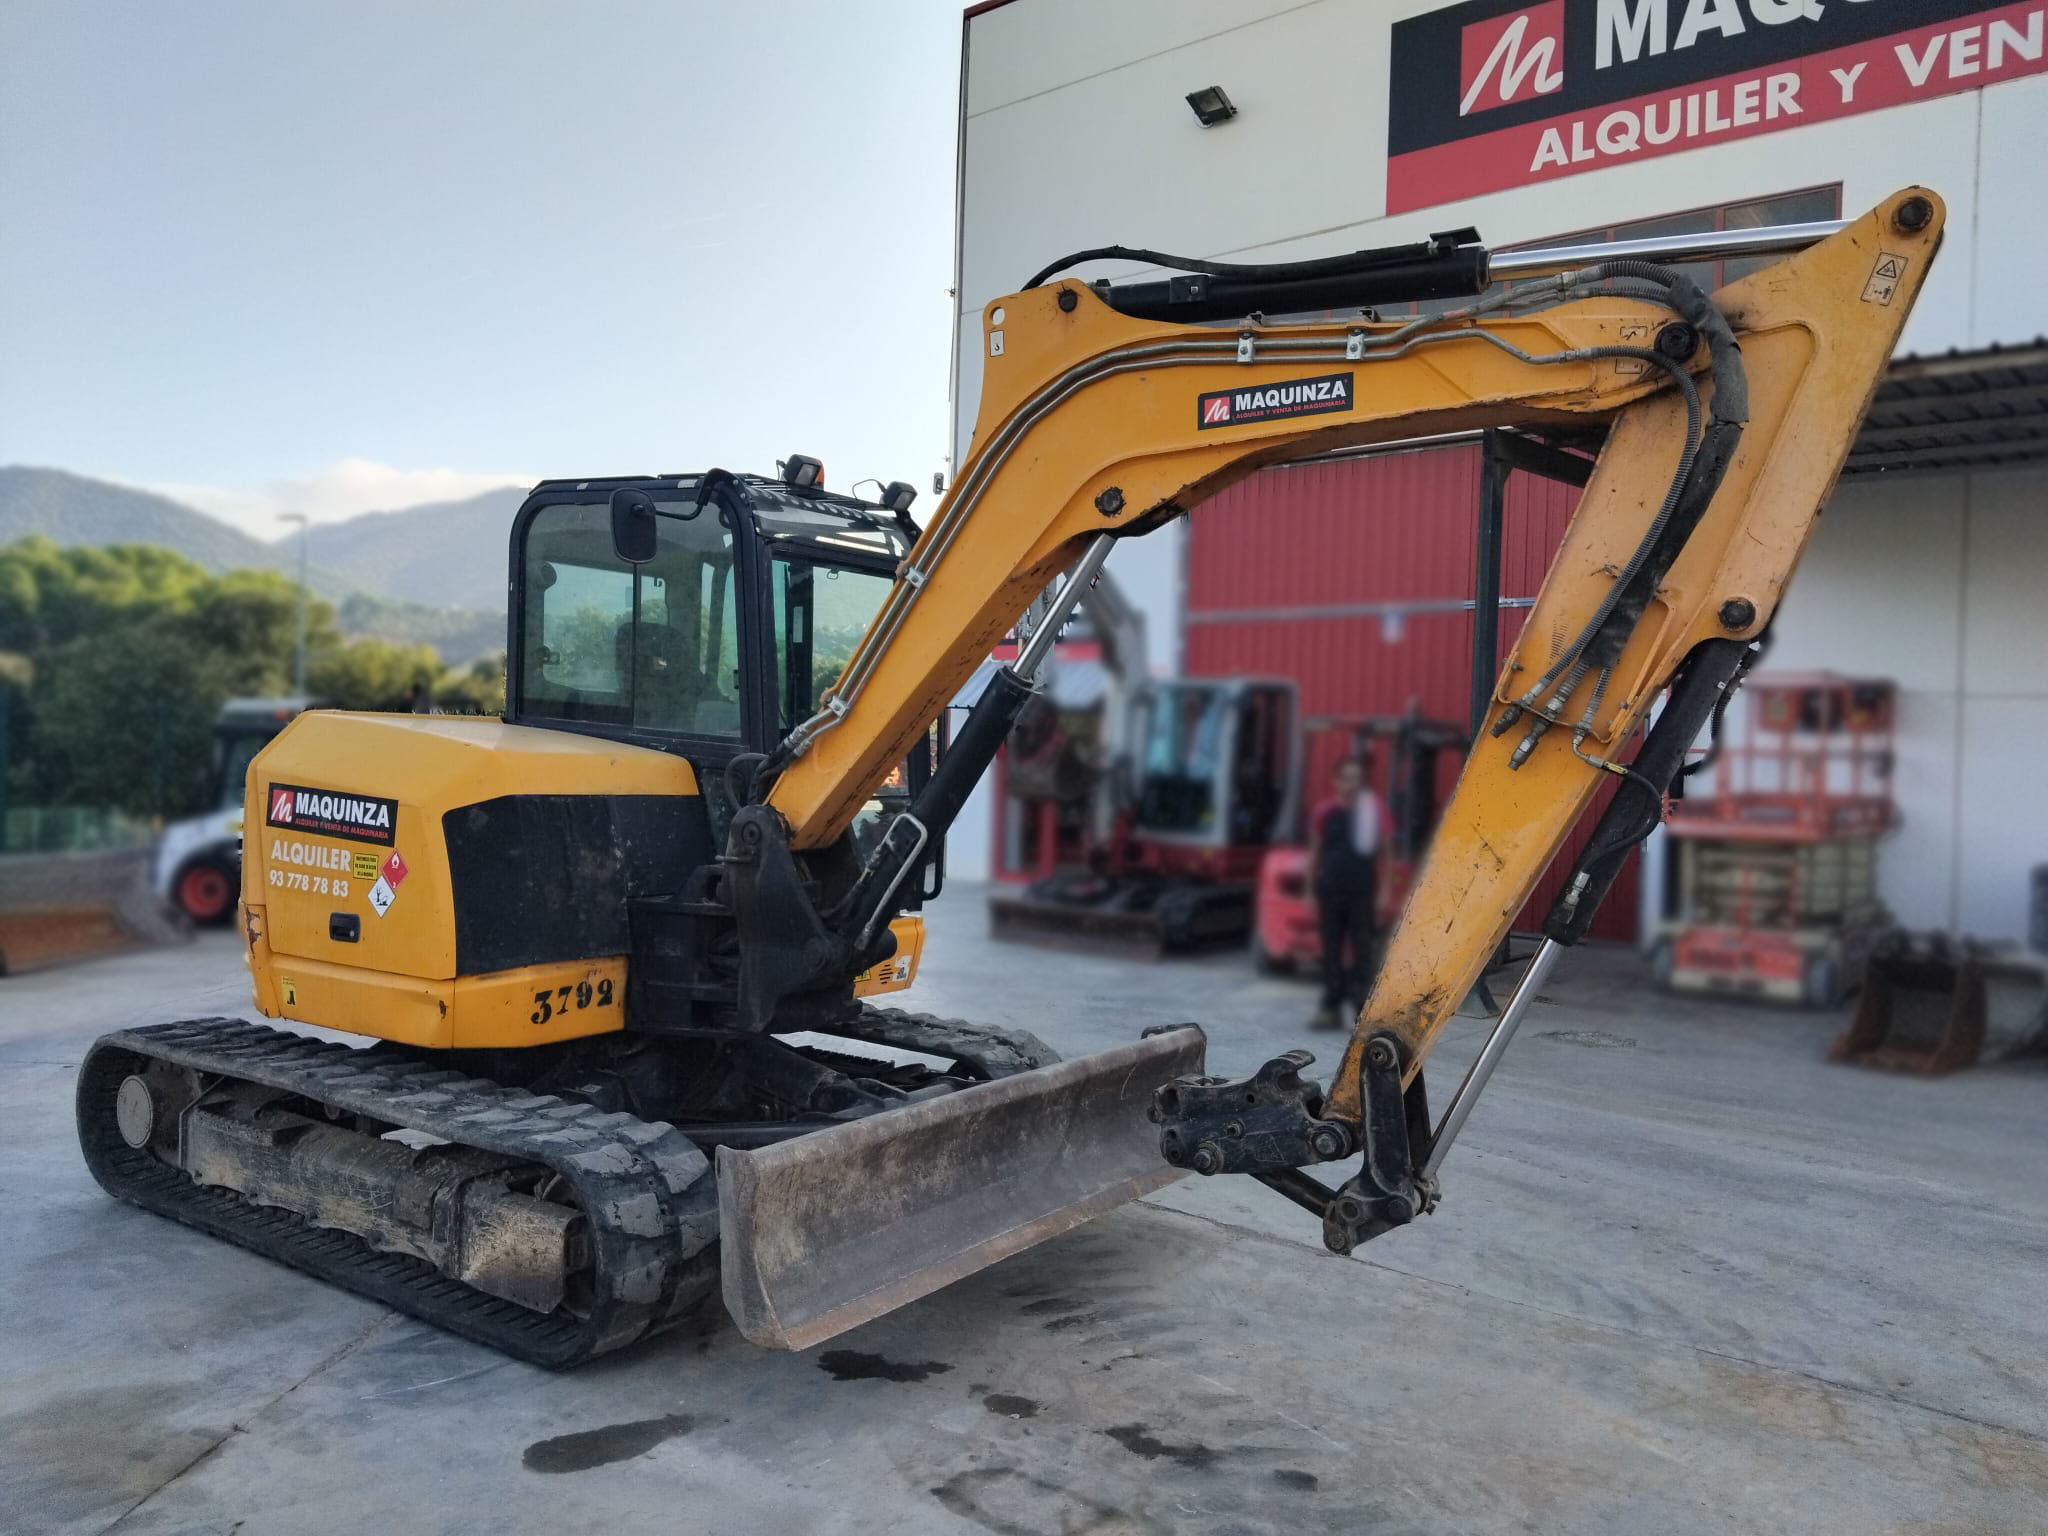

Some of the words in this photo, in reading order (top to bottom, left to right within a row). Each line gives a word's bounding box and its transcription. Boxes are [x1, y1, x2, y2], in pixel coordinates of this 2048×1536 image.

[1596, 0, 1877, 70] MA
[1530, 73, 1803, 171] ALQUILER
[1830, 62, 1867, 103] Y
[1894, 10, 2044, 87] VEN
[1235, 380, 1346, 411] MAQUINZA
[295, 792, 389, 828] MAQUINZA
[271, 839, 351, 872] ALQUILER
[270, 869, 283, 887] 93
[287, 872, 309, 891] 778
[313, 876, 328, 894] 78
[332, 880, 348, 897] 83
[530, 978, 613, 1024] 3792
